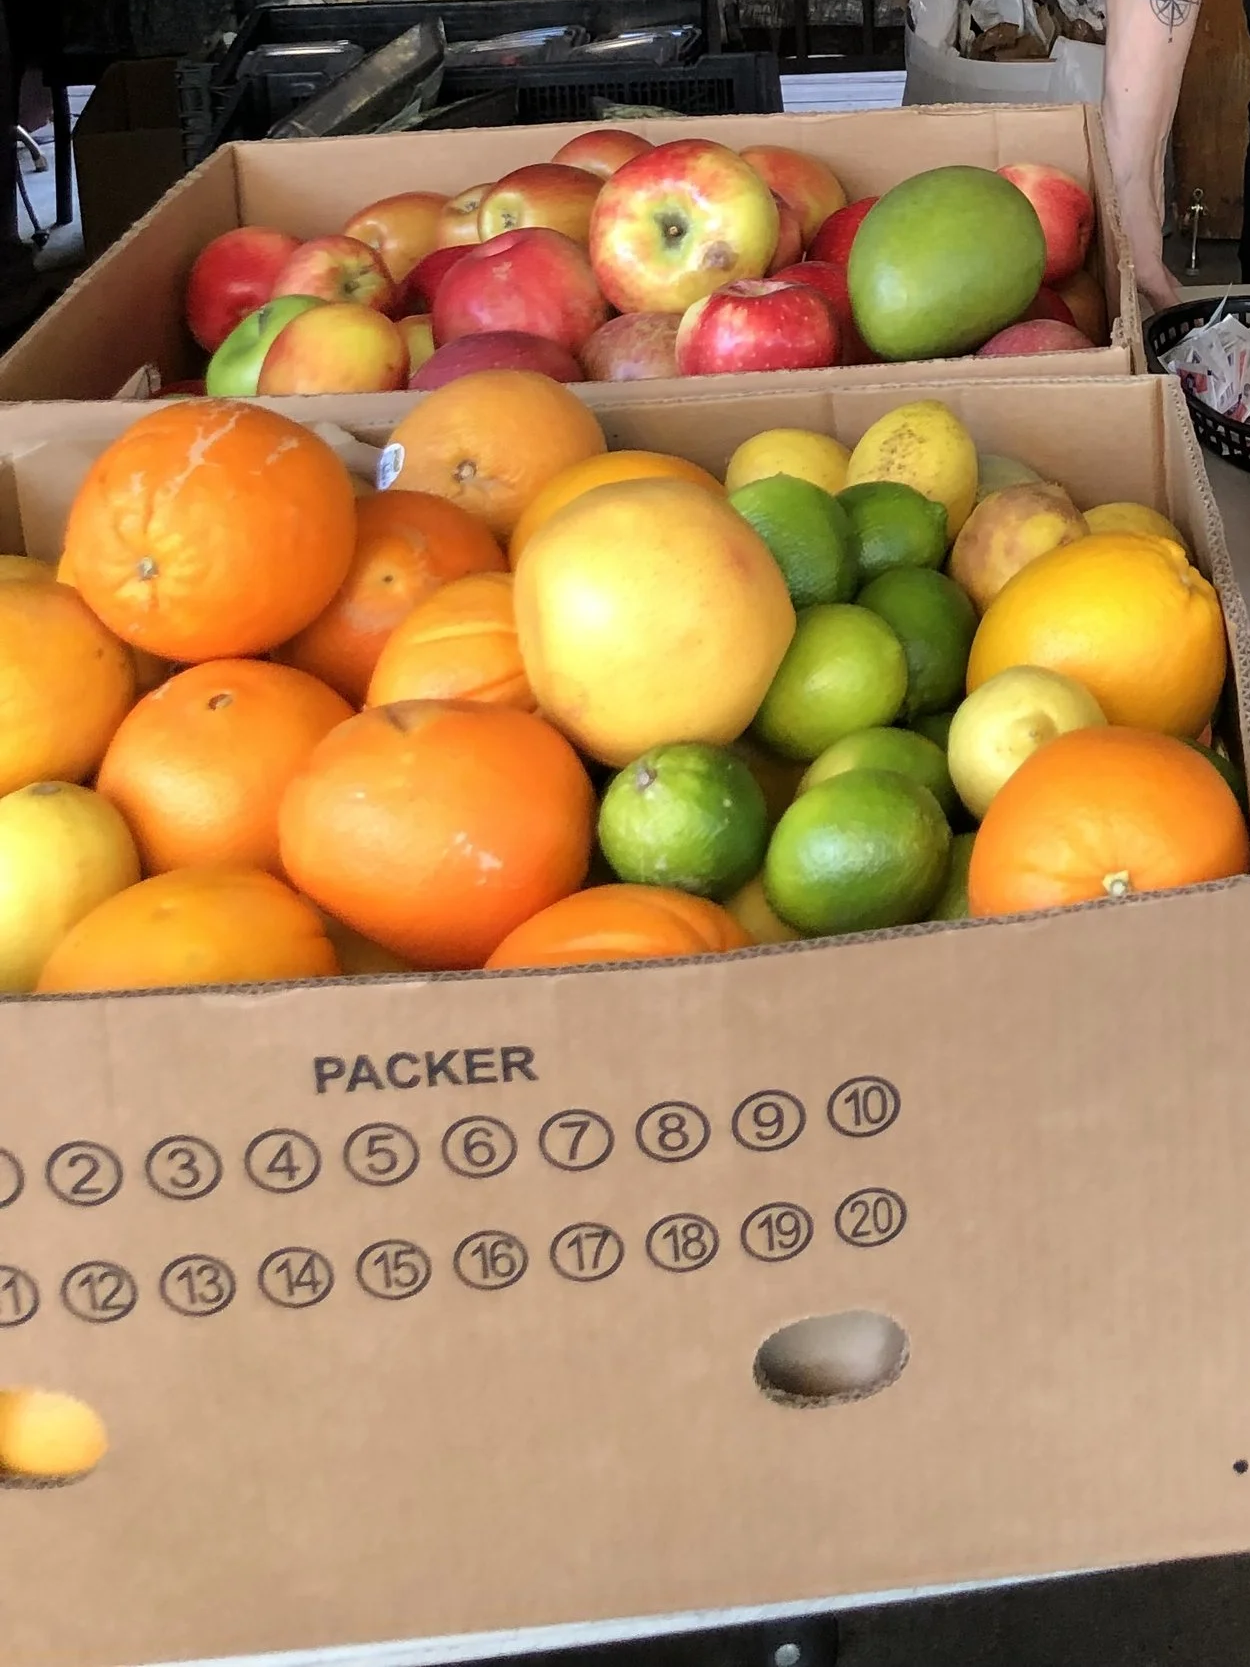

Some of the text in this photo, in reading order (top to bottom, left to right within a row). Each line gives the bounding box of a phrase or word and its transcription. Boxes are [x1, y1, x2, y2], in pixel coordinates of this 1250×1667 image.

[313, 1045, 539, 1094] PACKER
[69, 1085, 888, 1194] 2 3 4 5 6 7 8 9 10
[78, 1270, 128, 1312] 12
[177, 1263, 225, 1305] 13
[276, 1253, 322, 1297] 14
[373, 1246, 420, 1289] 15
[471, 1239, 516, 1280] 16
[567, 1229, 611, 1271] 17
[662, 1222, 707, 1263] 18
[757, 1210, 801, 1251] 19
[850, 1197, 893, 1238] 20
